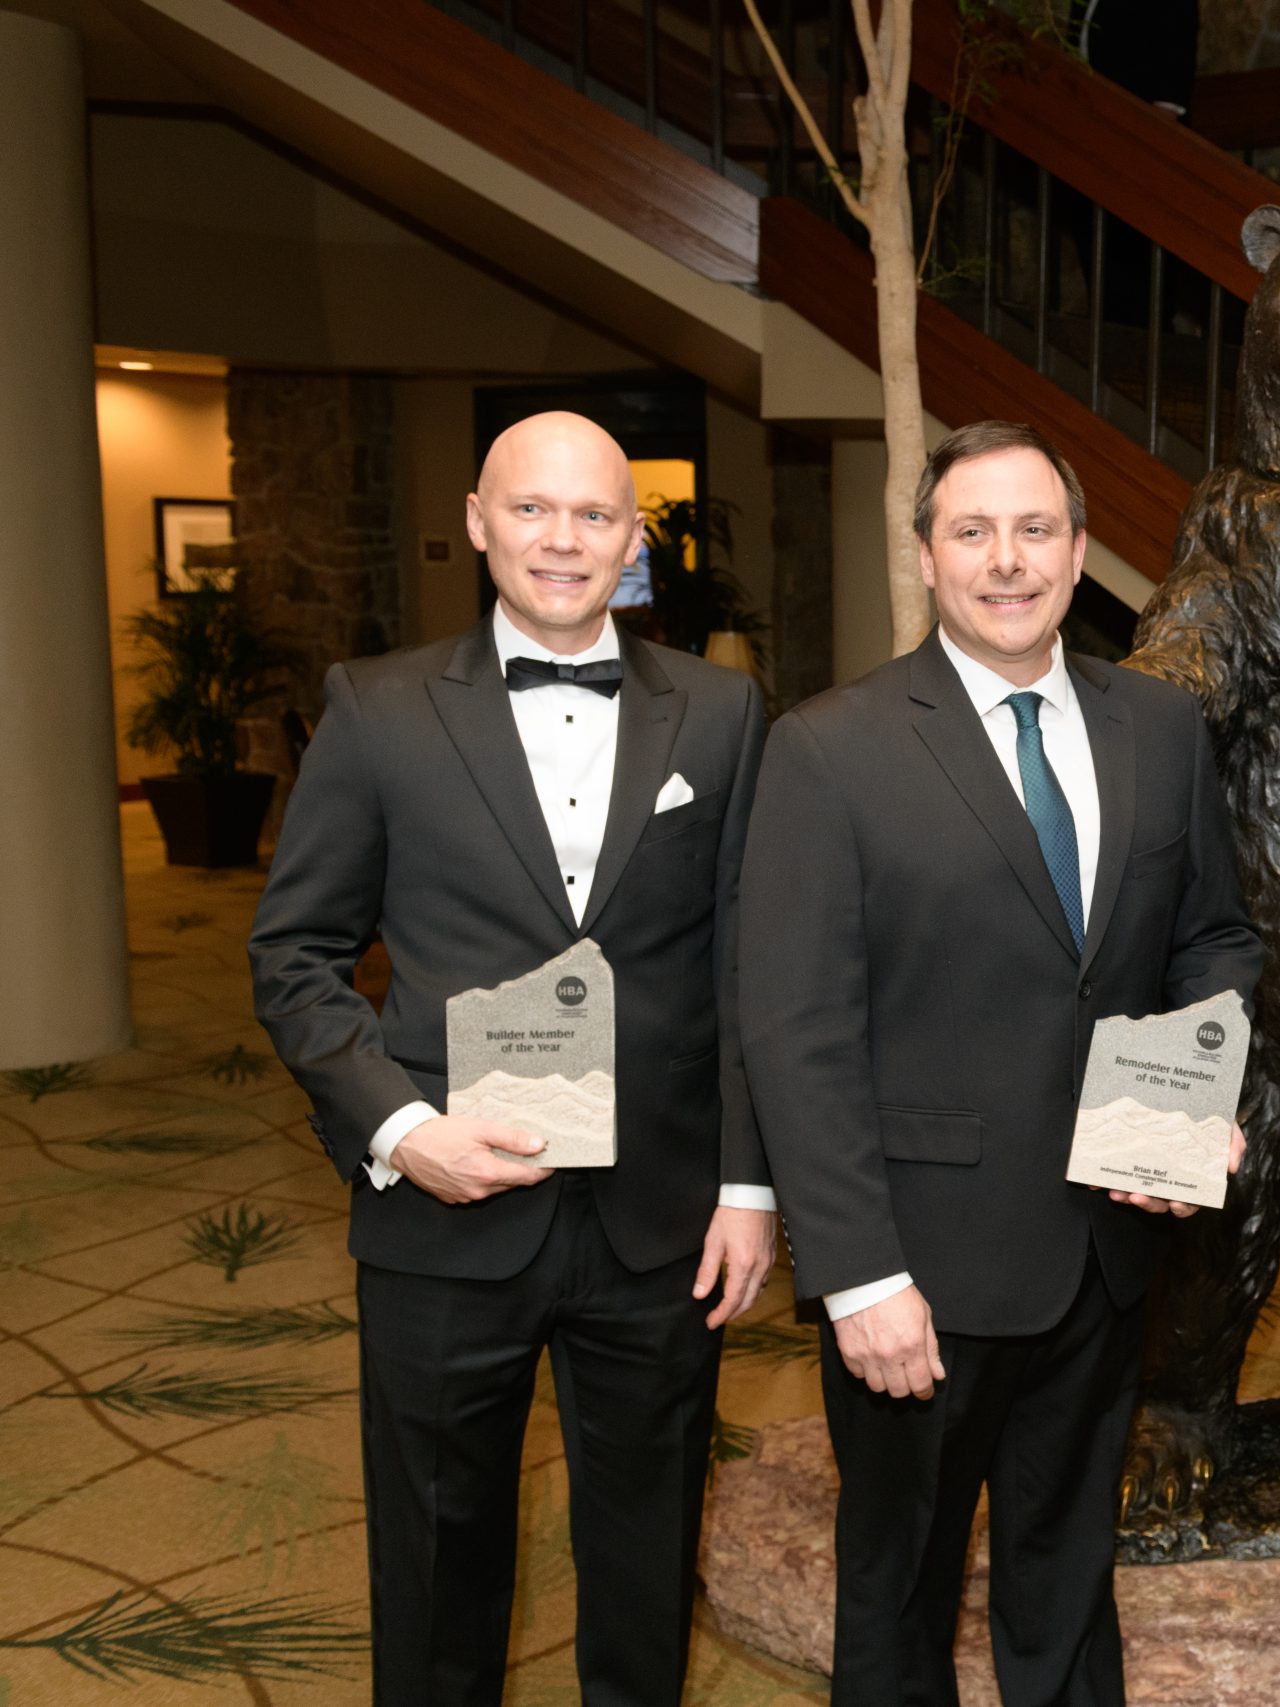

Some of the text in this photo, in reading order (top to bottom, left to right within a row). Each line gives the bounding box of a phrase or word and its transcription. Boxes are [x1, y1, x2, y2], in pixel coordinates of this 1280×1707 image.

[558, 986, 585, 996] HBA
[486, 1029, 575, 1041] Builder Member
[1198, 1029, 1223, 1042] HBA
[500, 1043, 561, 1053] of the Year
[1115, 1056, 1217, 1082] Remodeler Member
[1135, 1073, 1191, 1090] of the Year
[1133, 1165, 1152, 1174] Brian
